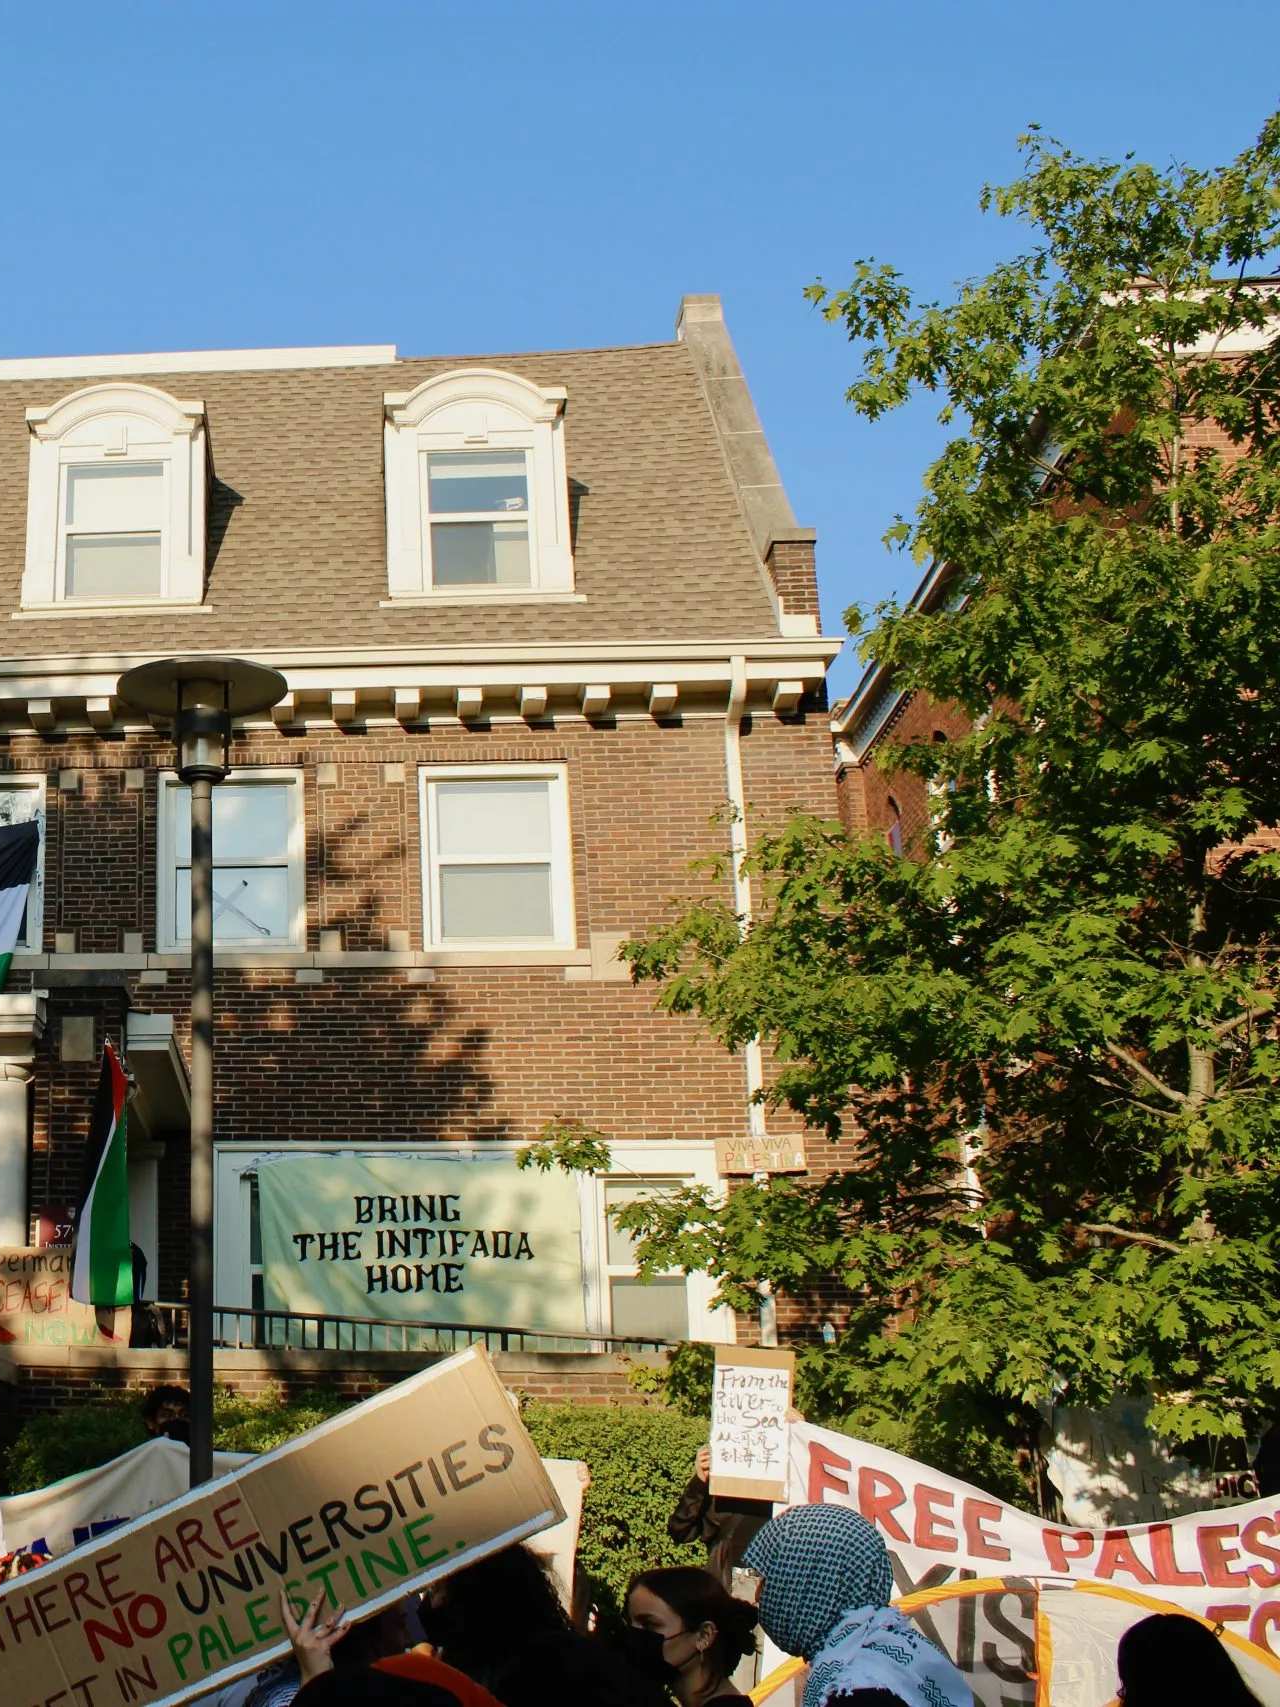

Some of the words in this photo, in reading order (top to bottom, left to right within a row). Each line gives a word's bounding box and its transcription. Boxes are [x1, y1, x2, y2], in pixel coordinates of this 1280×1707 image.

[726, 1140, 755, 1152] VIVA
[761, 1137, 792, 1151] VIVA
[725, 1151, 805, 1170] PALESTINA
[354, 1194, 461, 1225] BRING
[54, 1224, 74, 1238] 57
[292, 1231, 363, 1262] THE
[374, 1227, 536, 1260] INTIFADA
[363, 1262, 465, 1294] HOME
[25, 1319, 99, 1345] NOW
[718, 1368, 766, 1390] From
[768, 1374, 788, 1389] the
[716, 1391, 773, 1410] River
[717, 1412, 737, 1425] the
[742, 1411, 783, 1431] Sea
[808, 1440, 1011, 1561] FREE
[1042, 1510, 1280, 1588] PALES
[82, 1593, 168, 1663] NO
[176, 1423, 516, 1616] UNIVERSITIES
[154, 1498, 262, 1584] ARE
[115, 1654, 158, 1702] IN
